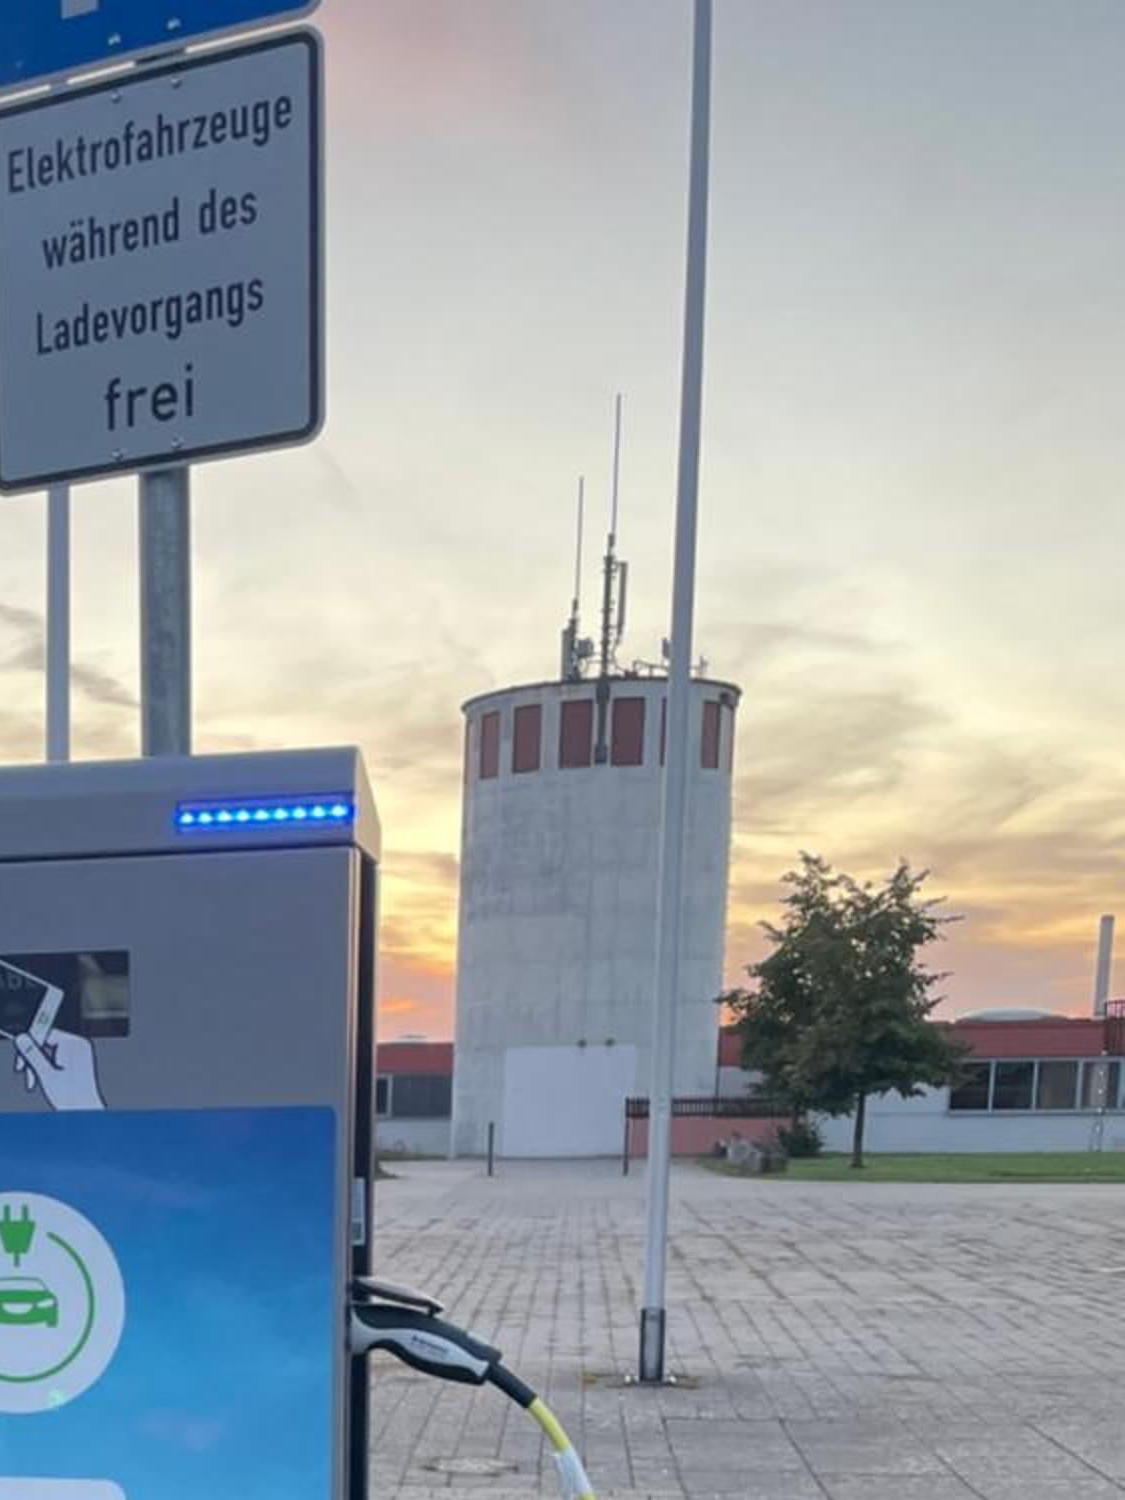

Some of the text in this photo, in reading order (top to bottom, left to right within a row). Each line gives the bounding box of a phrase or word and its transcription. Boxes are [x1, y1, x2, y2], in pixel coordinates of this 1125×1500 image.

[7, 95, 293, 194] Elektrofahrzeuge
[42, 188, 257, 270] während des
[36, 276, 265, 356] Ladevorgangs
[105, 363, 195, 432] frei
